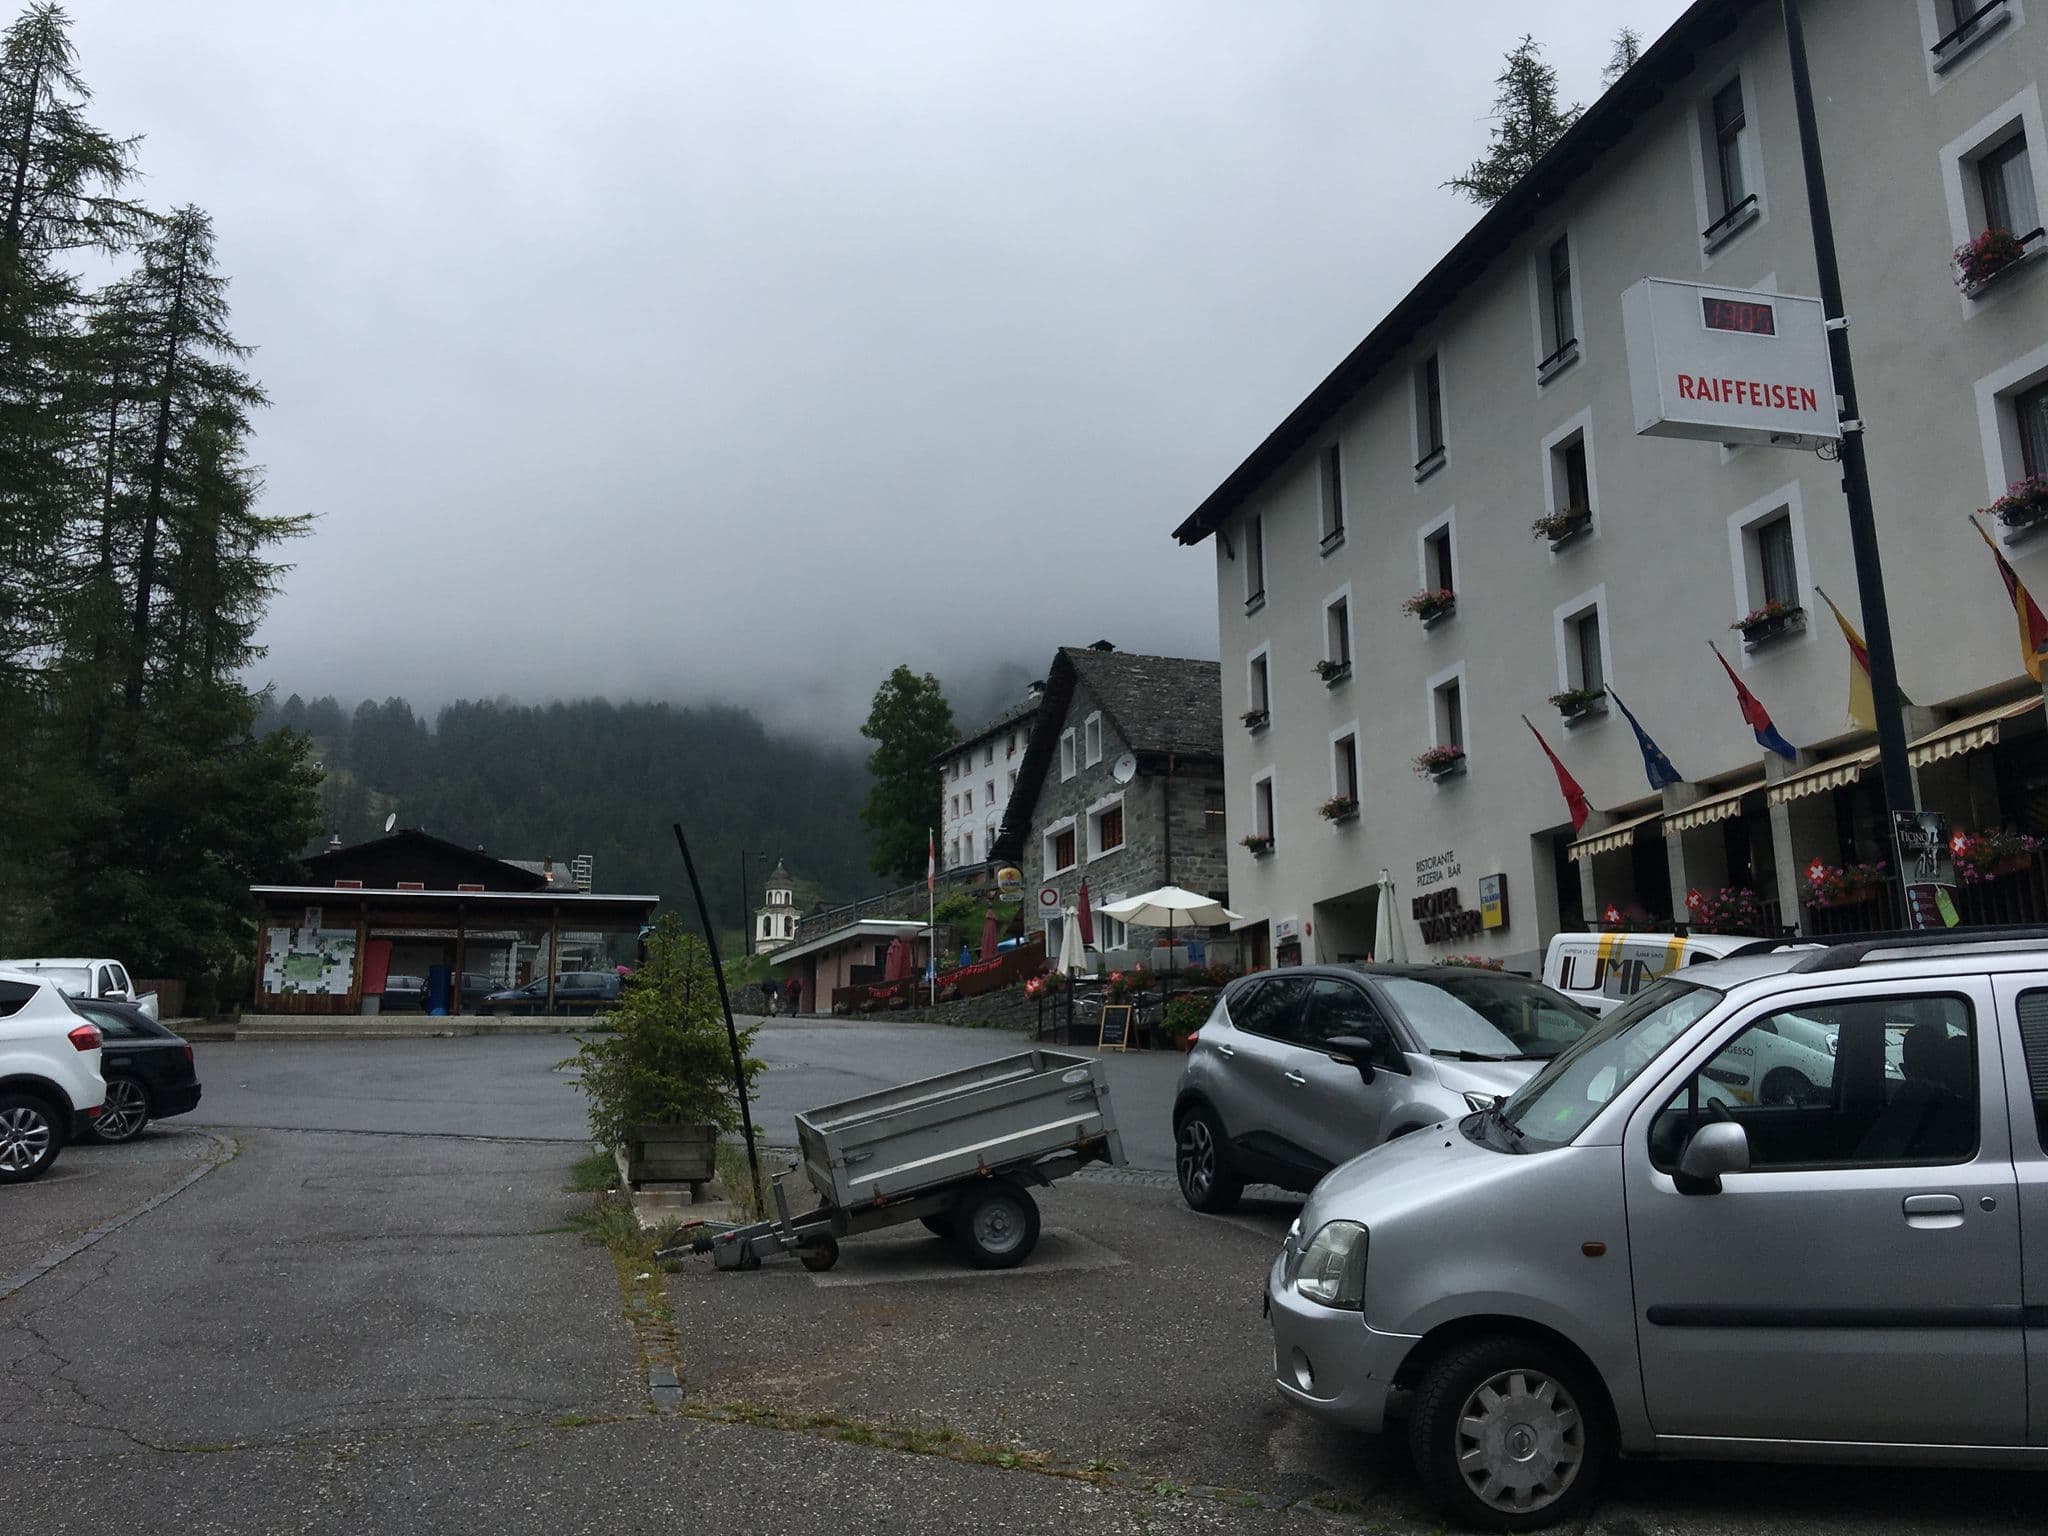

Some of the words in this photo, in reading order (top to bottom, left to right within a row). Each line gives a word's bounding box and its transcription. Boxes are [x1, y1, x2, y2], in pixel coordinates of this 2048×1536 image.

[1677, 374, 1818, 412] RAIFFEISEN
[1415, 850, 1455, 873] RISTORANTE
[1417, 871, 1443, 887] PIZZERIA
[1447, 864, 1461, 879] BAR
[1412, 887, 1462, 920] HOTEL
